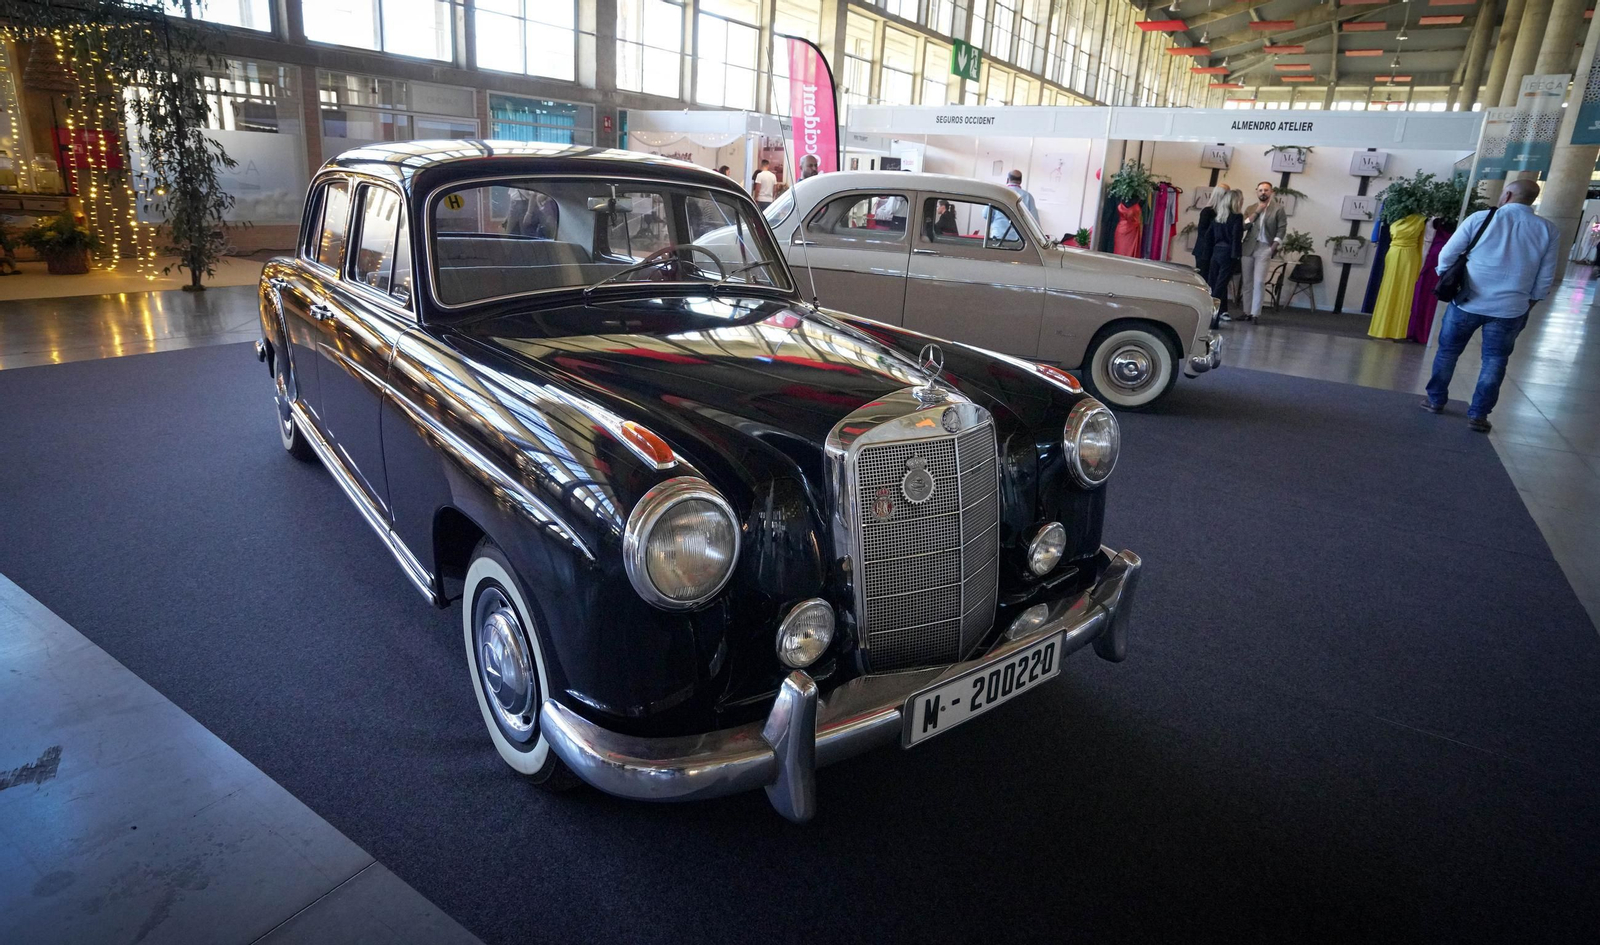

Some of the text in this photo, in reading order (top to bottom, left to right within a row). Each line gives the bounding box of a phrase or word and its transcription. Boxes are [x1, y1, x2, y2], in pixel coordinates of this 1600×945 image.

[1524, 81, 1564, 91] IFECA
[936, 115, 996, 125] SEGUROS OCCIDENT
[1231, 120, 1314, 131] ALMENDRO ATELIER
[448, 195, 460, 209] H
[970, 642, 1056, 712] 200220
